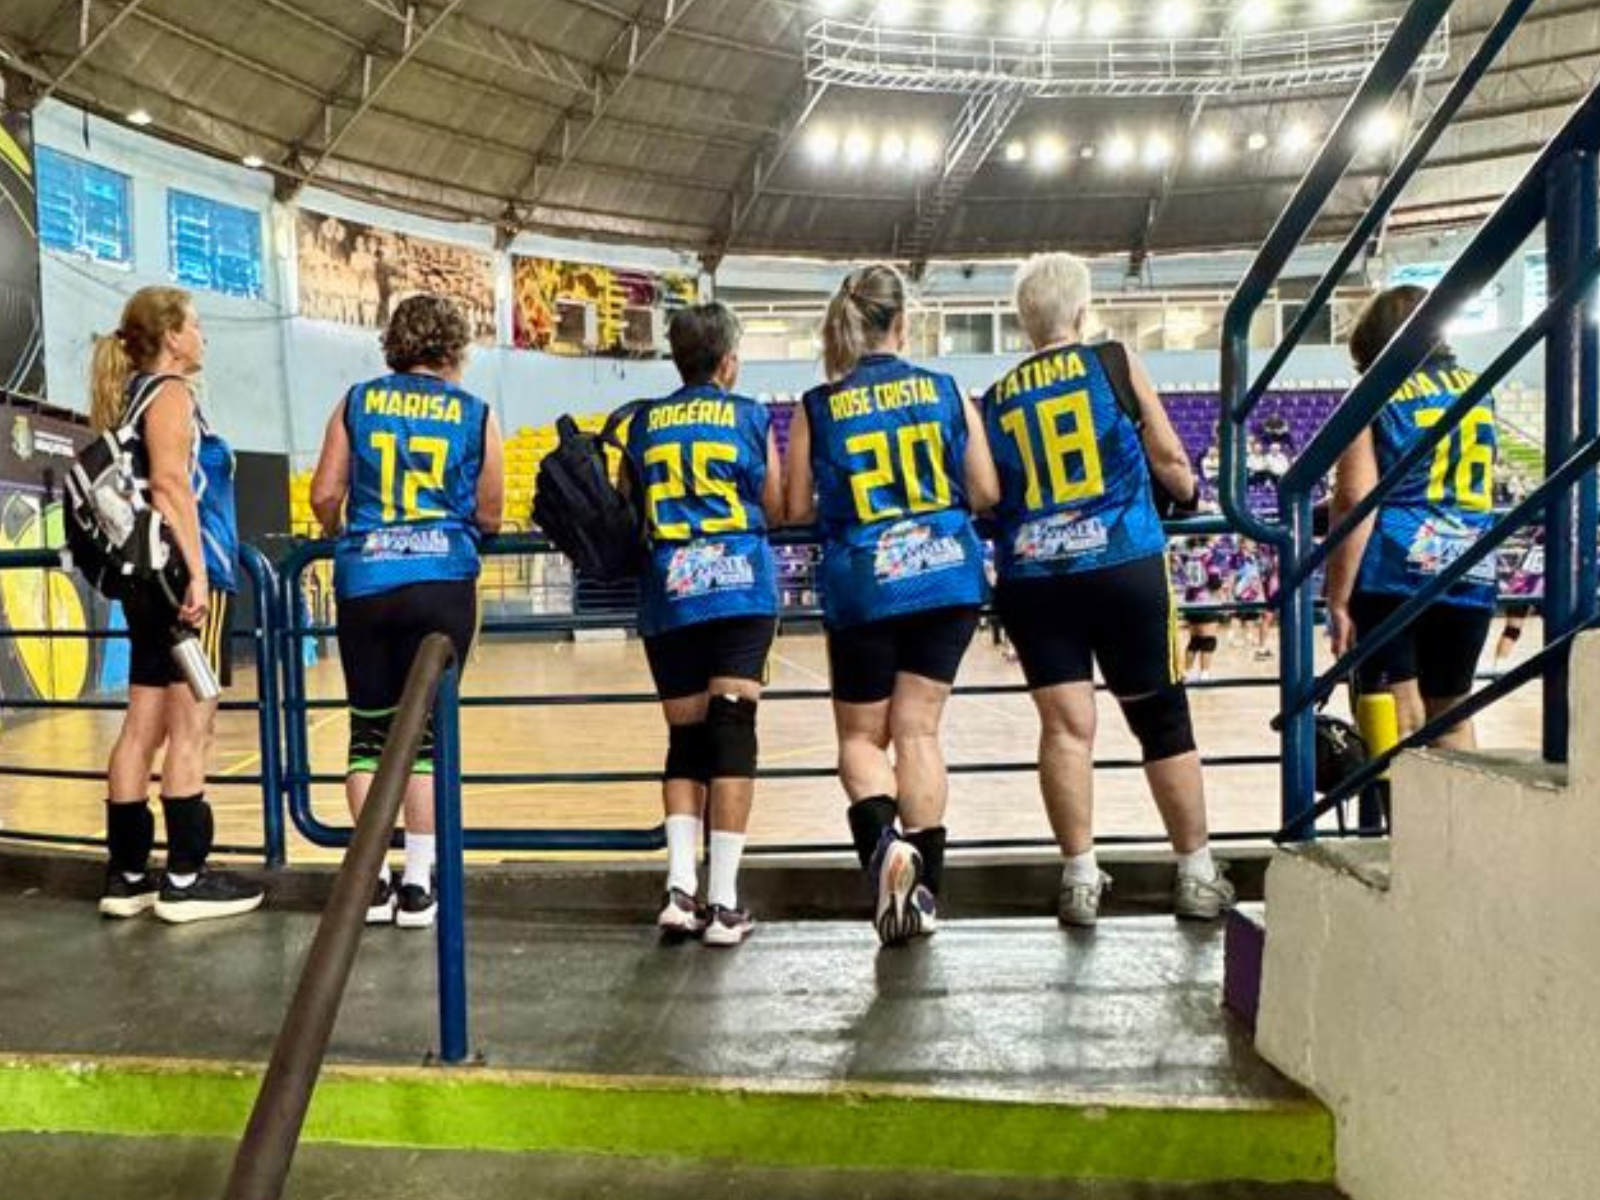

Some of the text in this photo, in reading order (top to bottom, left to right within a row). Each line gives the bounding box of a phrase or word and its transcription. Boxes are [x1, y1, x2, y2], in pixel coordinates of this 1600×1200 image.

[364, 387, 462, 425] MARISA
[646, 397, 736, 433] ROGÉRIA
[829, 376, 940, 422] ROSE CRISTAL
[370, 430, 453, 523] 12
[643, 441, 748, 541] 25
[845, 422, 953, 524] 20
[1000, 389, 1106, 511] 18
